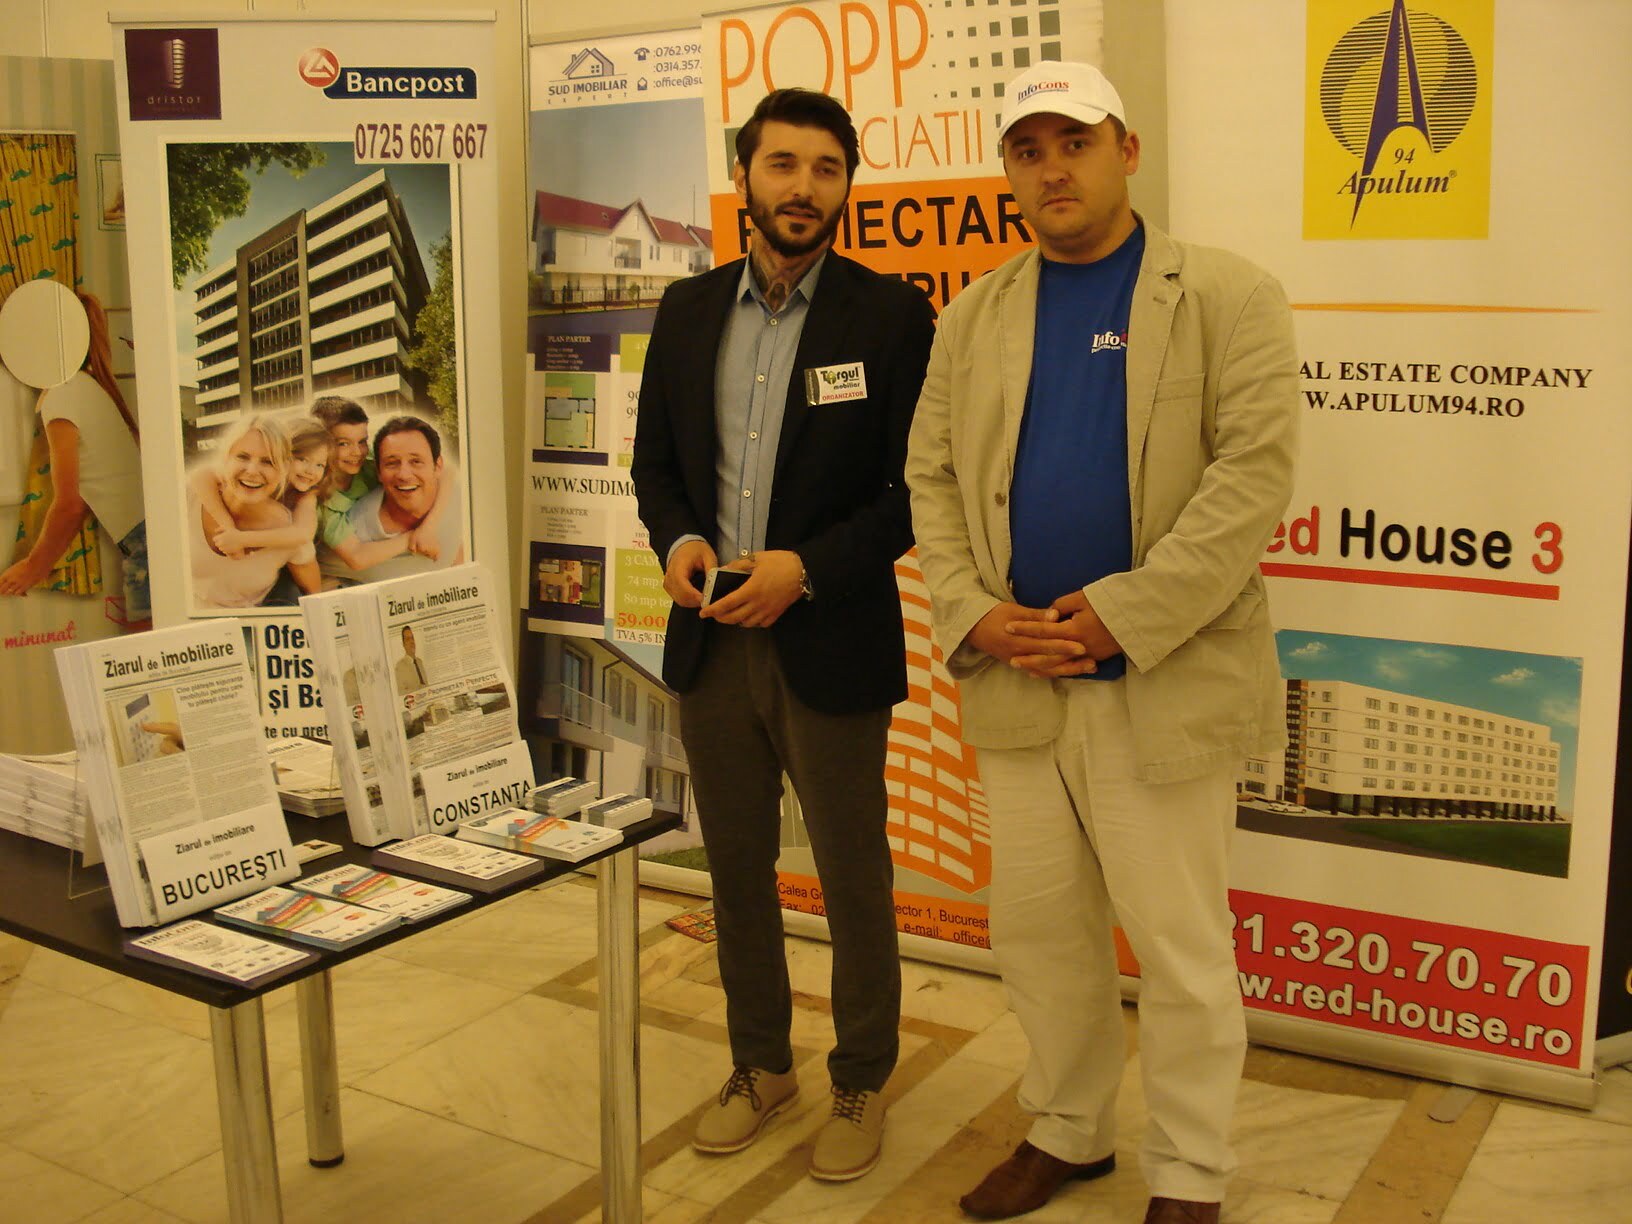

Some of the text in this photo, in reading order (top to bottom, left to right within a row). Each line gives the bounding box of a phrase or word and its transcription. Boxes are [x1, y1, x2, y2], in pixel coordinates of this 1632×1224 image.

[720, 0, 929, 123] POPP
[346, 71, 465, 98] Bancpost
[548, 78, 628, 96] SUD IMOBILIAR
[1018, 80, 1070, 101] InfoCons
[355, 123, 488, 159] 0725 667 667
[1394, 148, 1416, 165] 94
[1338, 361, 1442, 383] ESTATE
[1450, 364, 1593, 389] COMPANY
[1340, 507, 1513, 570] House
[1532, 521, 1564, 575] 3
[388, 596, 415, 617] Ziarul
[427, 585, 479, 608] imobiliare
[4, 620, 76, 650] minunat
[264, 624, 309, 650] Ofe
[616, 629, 637, 641] TVA
[638, 632, 653, 643] 5%
[104, 655, 144, 678] Ziarul
[147, 659, 159, 671] de
[160, 642, 235, 668] imobiliare
[267, 654, 314, 680] Dris
[282, 726, 298, 739] cu
[446, 767, 468, 782] Ziarul
[475, 757, 508, 773] imobiliare
[175, 838, 202, 855] Ziarul
[212, 824, 256, 844] imobiliare
[778, 882, 808, 898] Calea
